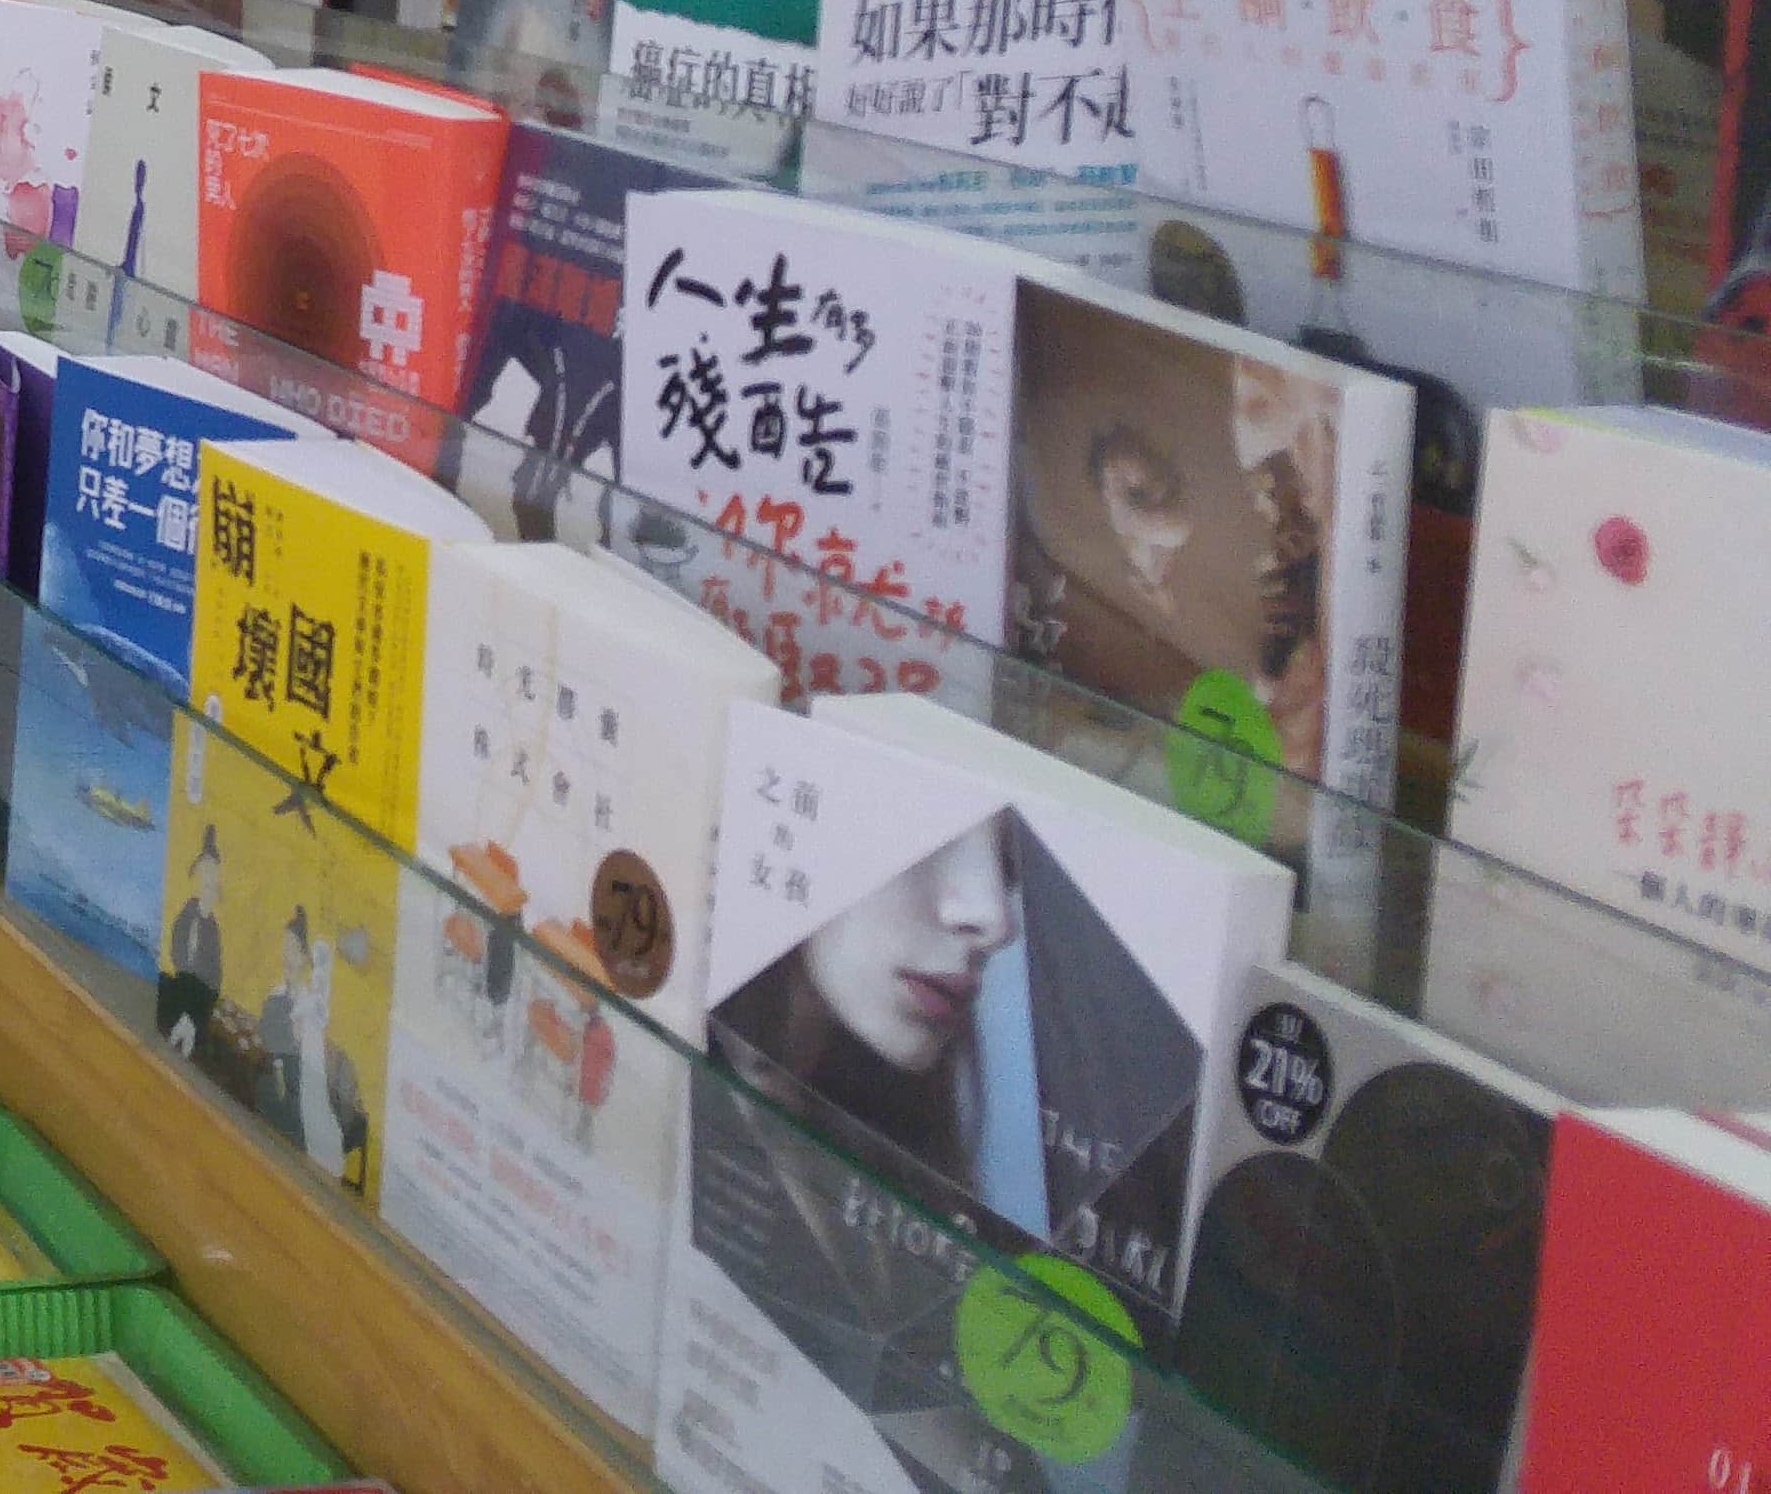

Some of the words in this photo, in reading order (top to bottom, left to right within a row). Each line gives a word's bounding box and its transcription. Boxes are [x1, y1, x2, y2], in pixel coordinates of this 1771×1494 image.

[79, 406, 197, 492] 你和夢想
[75, 463, 199, 557] 只差一個
